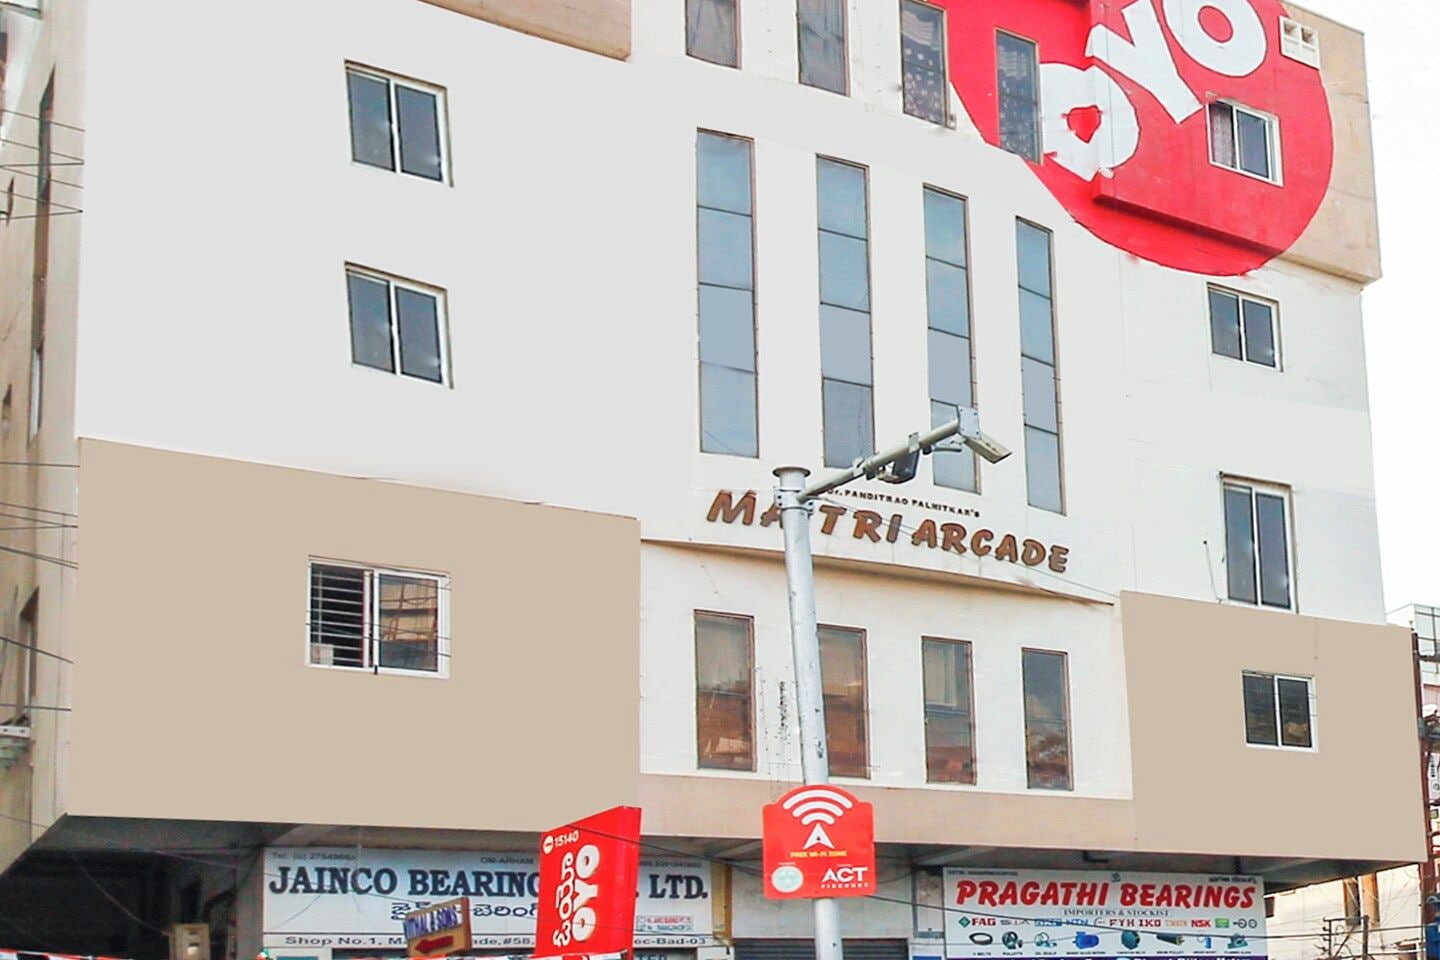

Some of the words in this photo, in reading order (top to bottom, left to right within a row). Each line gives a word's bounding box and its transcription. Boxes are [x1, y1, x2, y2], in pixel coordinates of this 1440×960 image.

[844, 490, 909, 506] PANDITRAO
[706, 490, 903, 544] MATRI
[911, 518, 1070, 573] ARCADE
[554, 830, 580, 848] 15140
[268, 865, 398, 896] JAINCO
[648, 874, 709, 899] LTD.
[821, 867, 869, 883] ACT
[572, 844, 600, 942] OYO
[956, 880, 1110, 908] PRAGATHI
[1119, 882, 1256, 910] BEARINGS
[1064, 908, 1117, 916] IMPORTERS
[1127, 909, 1169, 917] STOCKIST
[971, 917, 996, 926] FAG
[1109, 918, 1135, 927] FYH
[1138, 918, 1162, 927] IKO
[1190, 918, 1212, 928] NSK
[284, 936, 333, 947] Shop
